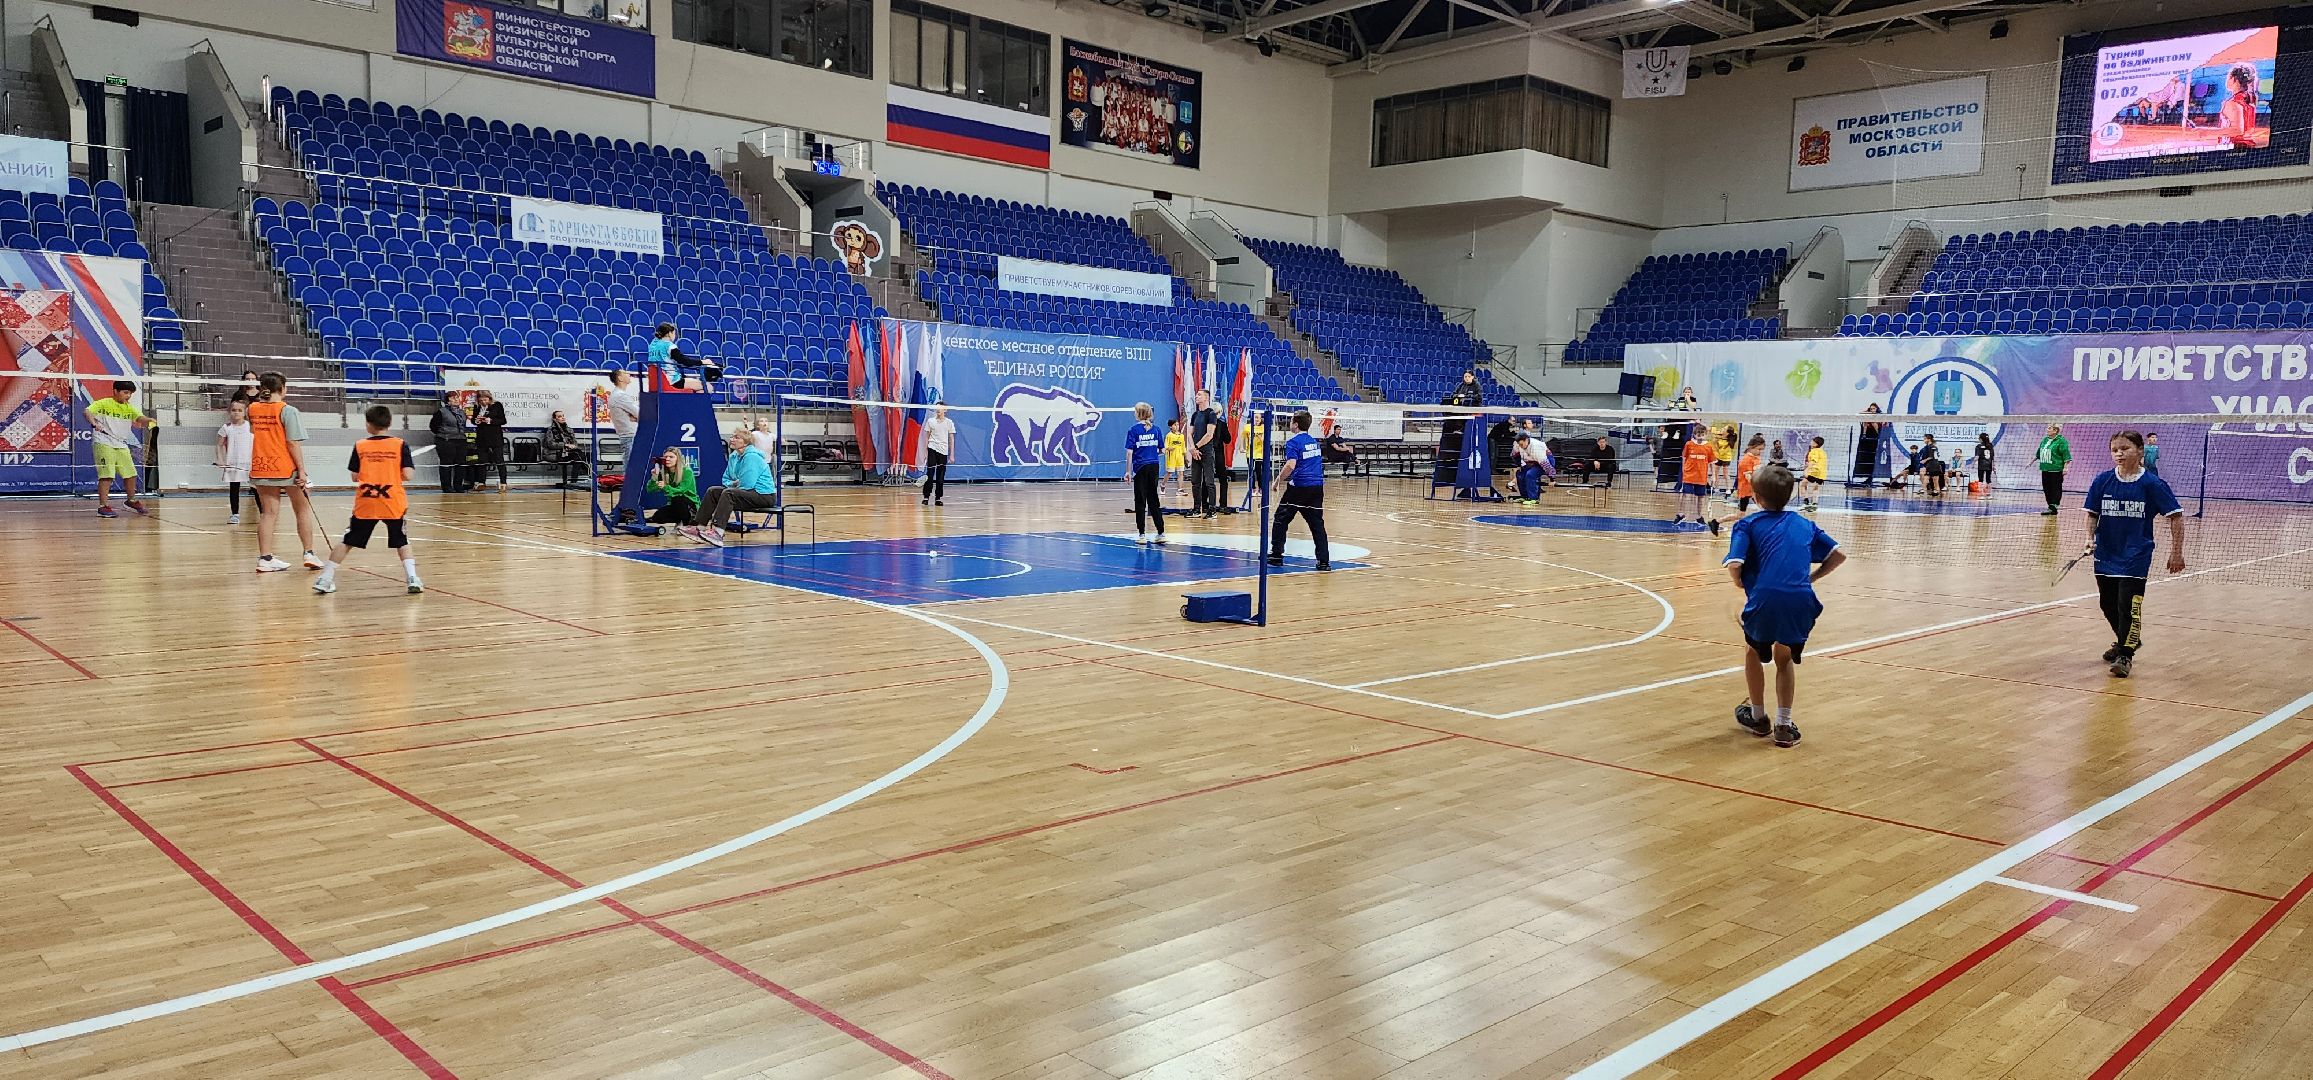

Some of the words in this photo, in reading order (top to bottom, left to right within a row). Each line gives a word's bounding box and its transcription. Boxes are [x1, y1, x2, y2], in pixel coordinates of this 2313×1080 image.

[495, 11, 590, 38] МИНИСТЕРСТВО
[495, 22, 578, 46] ФИЗИЧЕСКОЙ
[495, 33, 558, 53] КУЛЬТУРЫ
[561, 46, 569, 55] И
[572, 48, 617, 64] СПОРТА
[496, 45, 579, 67] МОСКОВСКОЙ
[496, 55, 553, 73] ОБЛАСТИ
[1644, 86, 1666, 95] FISU
[2100, 86, 2138, 100] 07.02
[1836, 102, 1979, 131] ПРАВИТЕЛЬСТВО
[1849, 119, 1963, 145] МОСКОВСКОЙ
[1865, 140, 1943, 159] ОБЛАСТИ
[1004, 273, 1062, 287] ПРИВЕТСТВУЕМ
[1001, 341, 1054, 355] местное
[1058, 345, 1122, 359] отделение
[1125, 347, 1152, 361] ВПП
[984, 360, 1045, 377] "ЕДИНАЯ
[1049, 365, 1105, 380] РОССИЯ"
[2073, 345, 2313, 381] ПРИВЕТСТВ
[680, 423, 696, 442] 2
